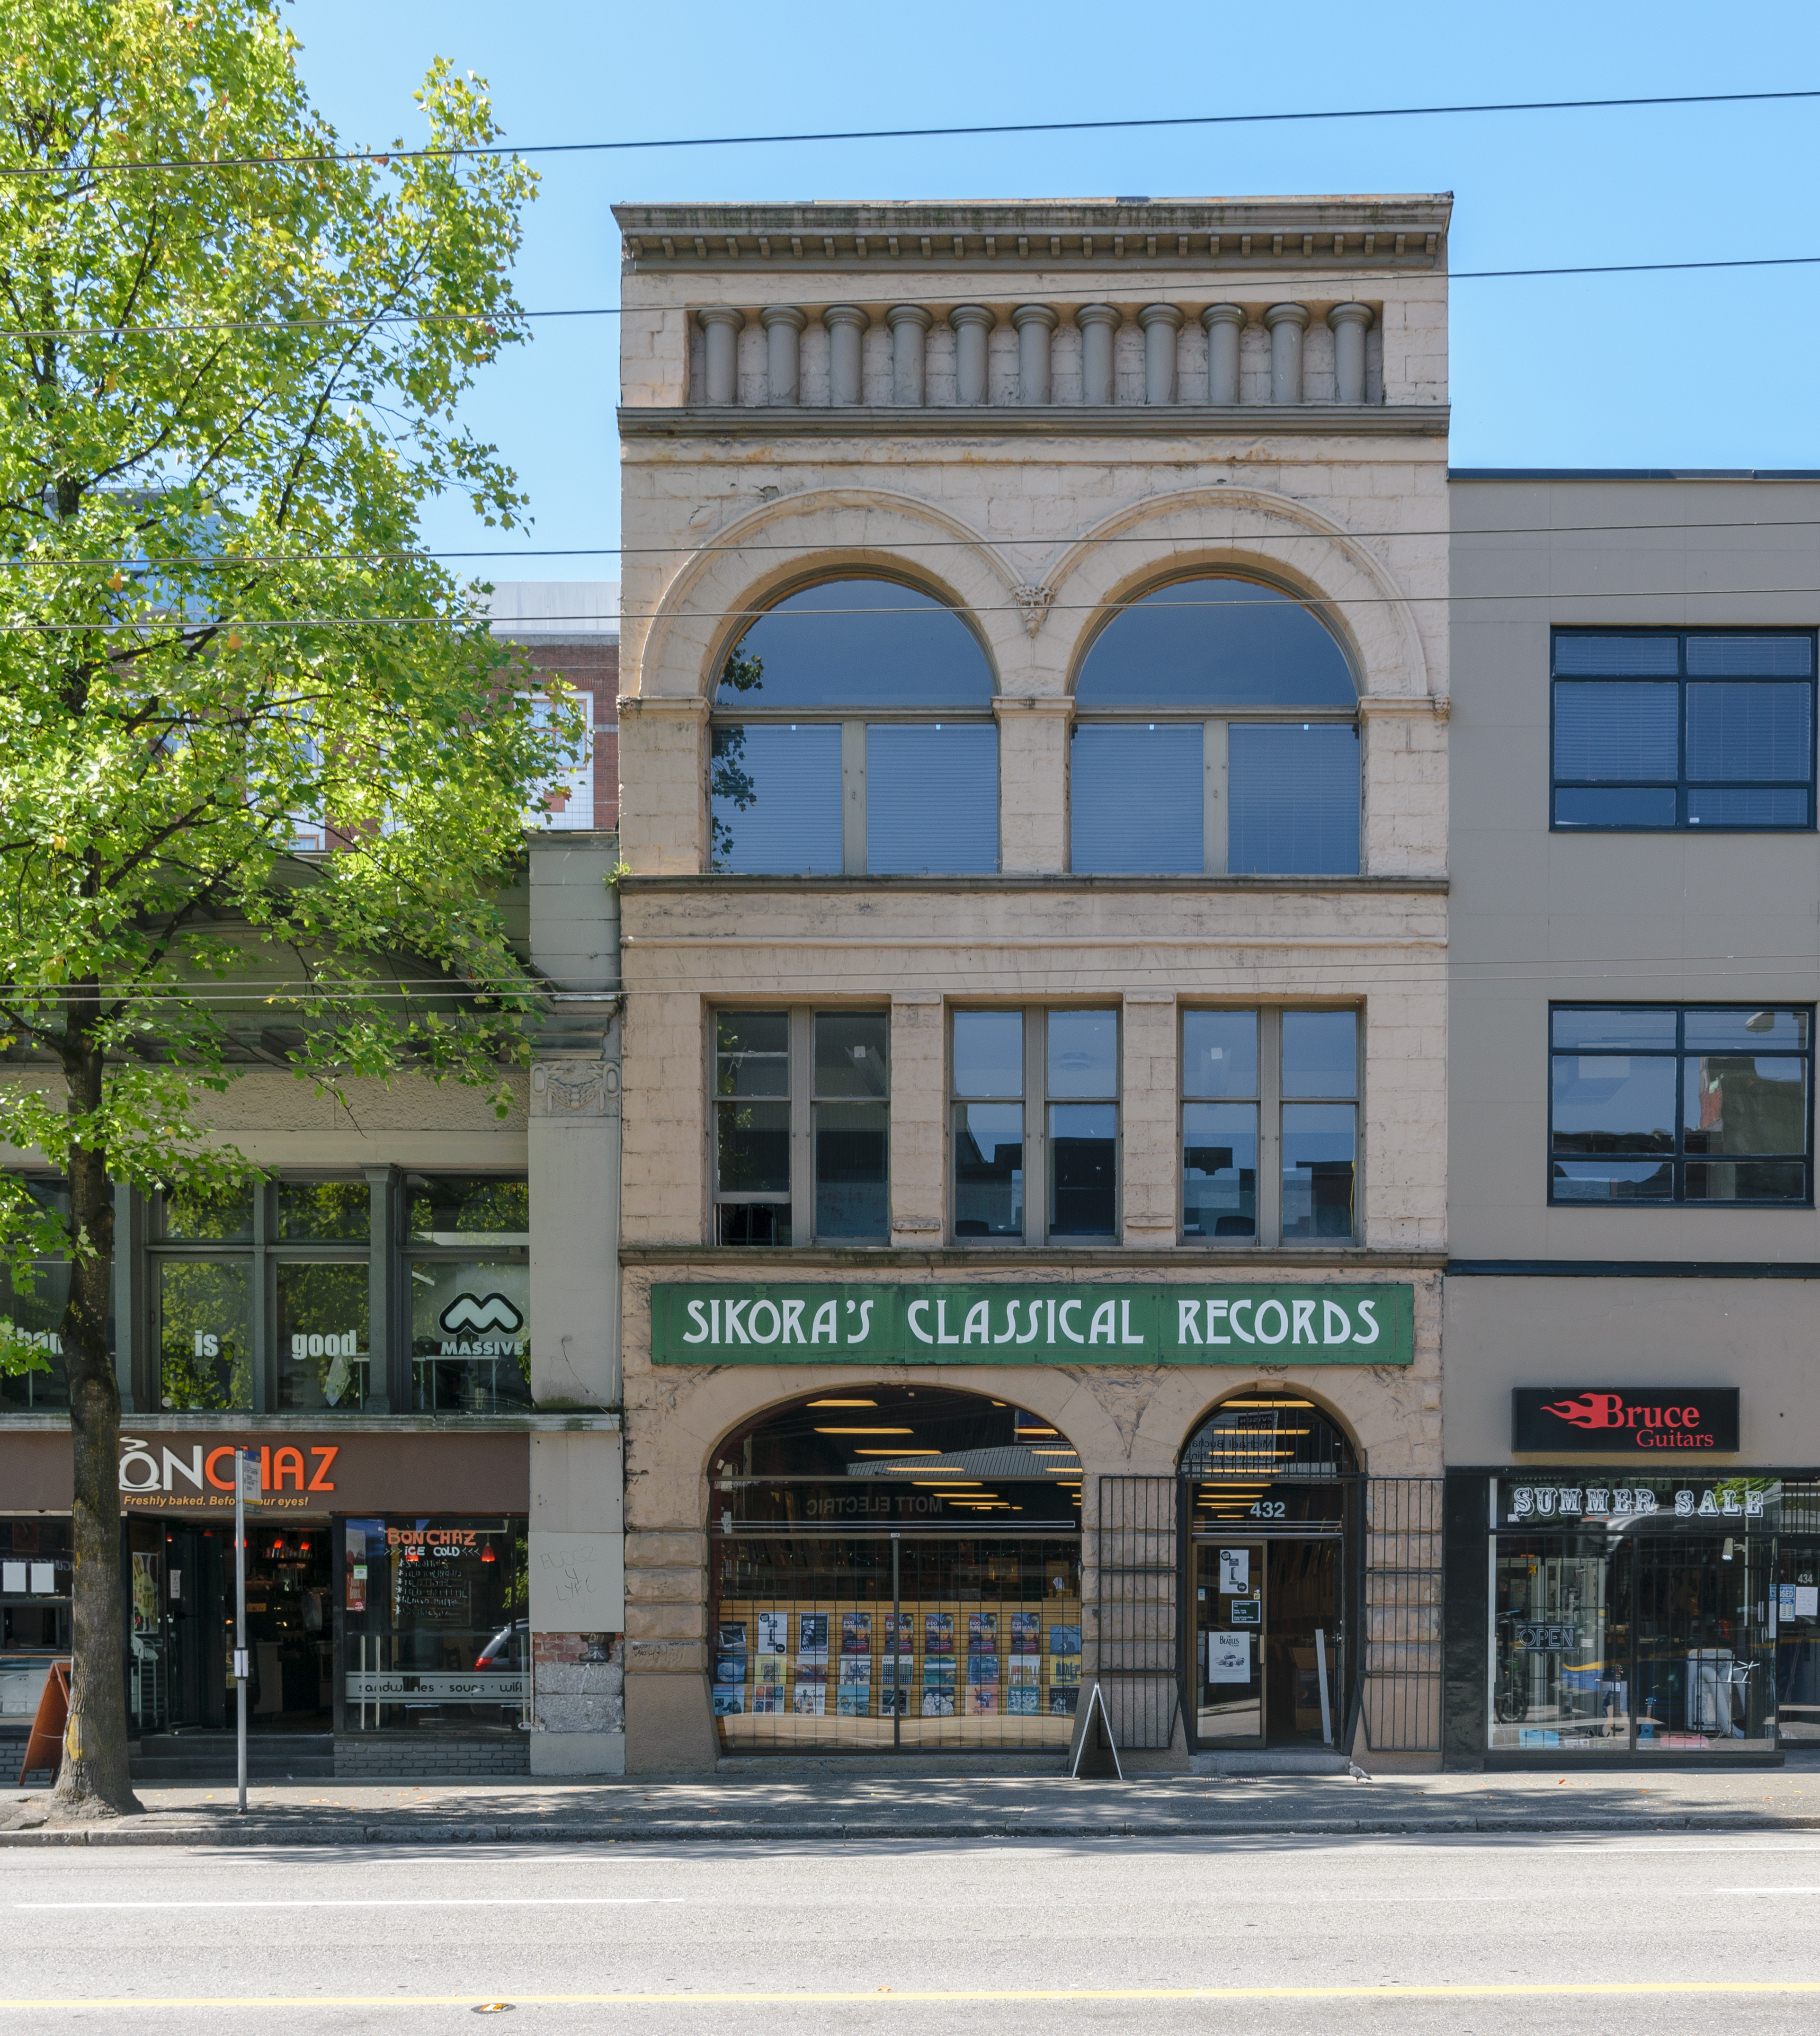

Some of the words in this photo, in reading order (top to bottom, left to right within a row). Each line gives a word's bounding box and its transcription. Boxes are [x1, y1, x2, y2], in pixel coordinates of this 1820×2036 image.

[682, 1299, 874, 1344] SIKORA'S
[907, 1299, 1144, 1344] CLASSICAL
[1177, 1299, 1380, 1344] RECORDS
[195, 1330, 218, 1357] is
[292, 1329, 357, 1360] good
[440, 1341, 524, 1355] MASSIVE
[1592, 1393, 1700, 1428] Bruce
[1636, 1429, 1714, 1447] Guitars
[124, 1495, 167, 1506] Freshly
[169, 1495, 206, 1505] baked.
[209, 1495, 236, 1505] Befo
[277, 1496, 309, 1507] eyes!
[1513, 1487, 1656, 1516] SUMMER
[1675, 1490, 1764, 1518] SALE
[1250, 1502, 1285, 1518] 432
[1798, 1574, 1813, 1584] 434
[1220, 1635, 1240, 1646] BEATLES
[1519, 1628, 1573, 1646] OPEN
[499, 1681, 522, 1692] wifi
